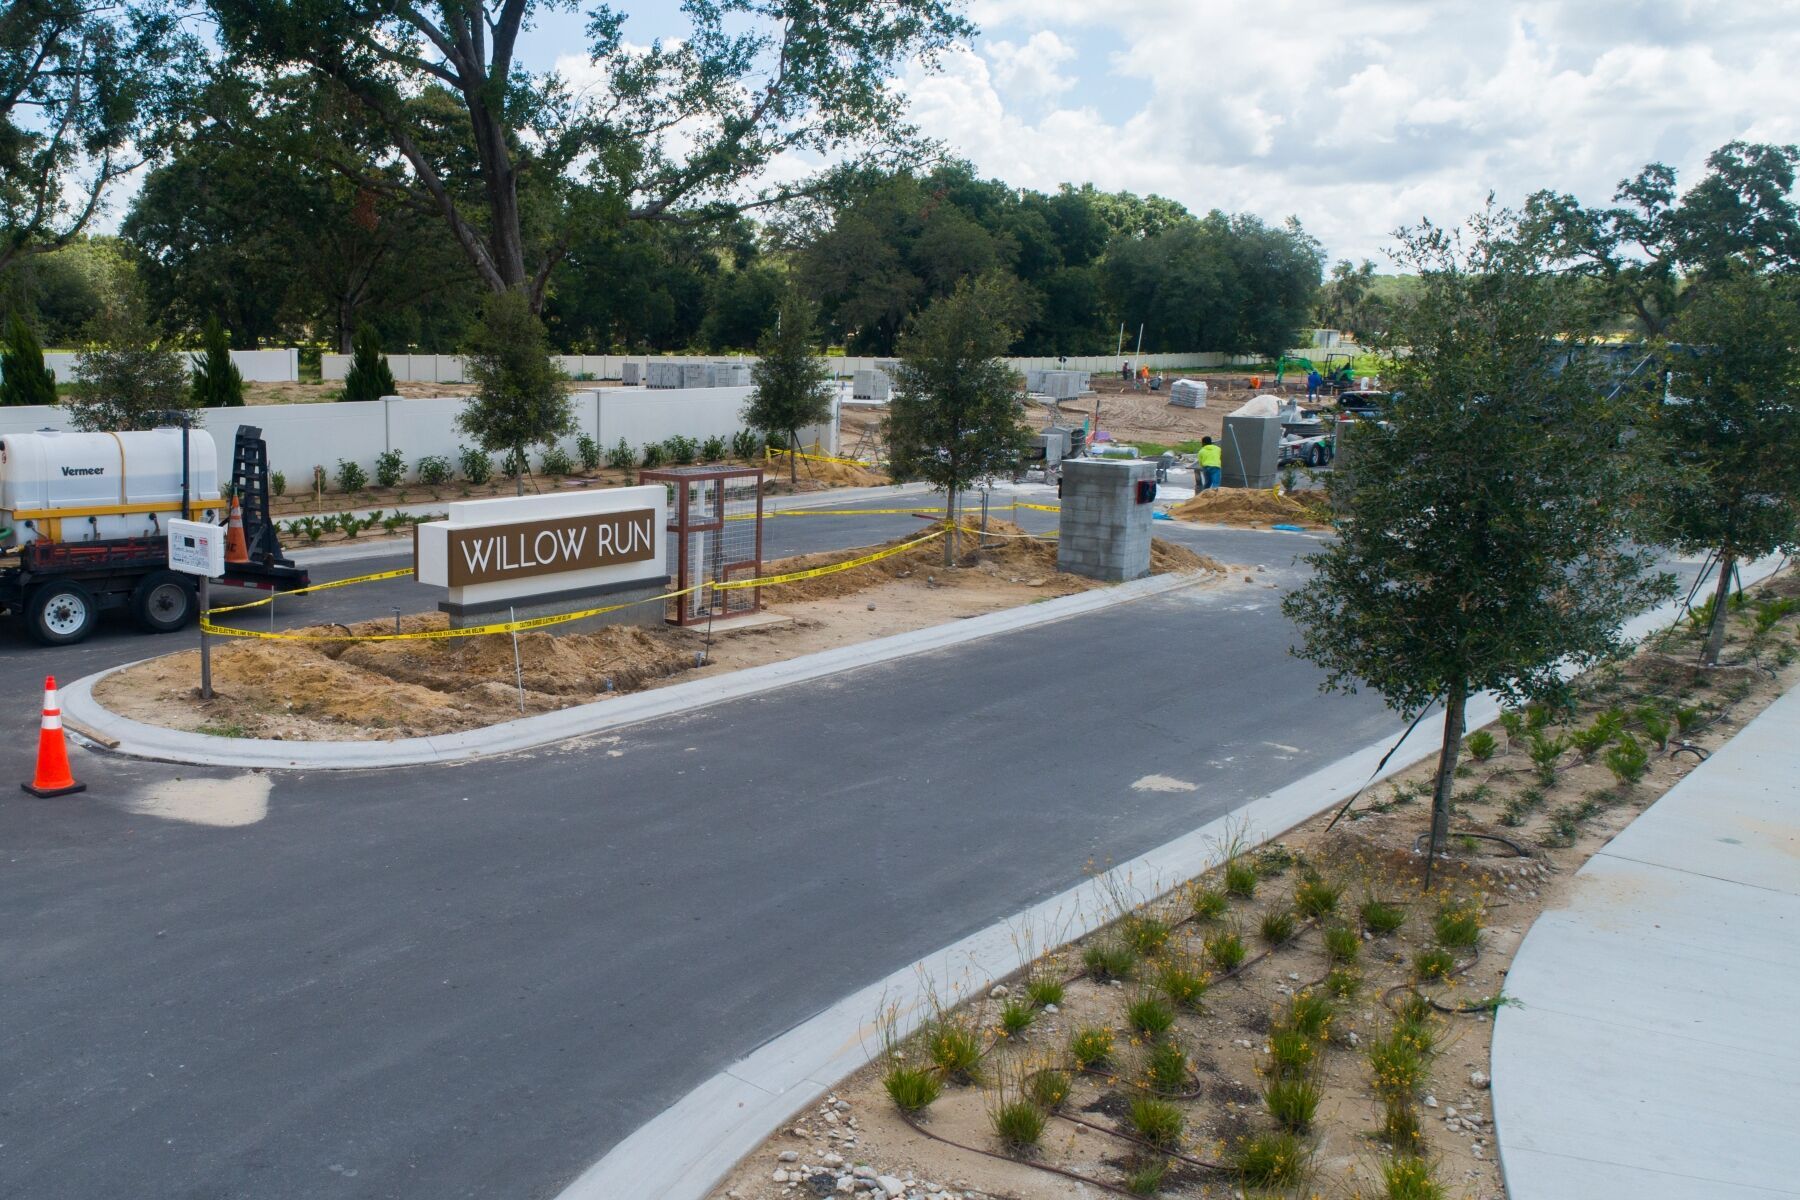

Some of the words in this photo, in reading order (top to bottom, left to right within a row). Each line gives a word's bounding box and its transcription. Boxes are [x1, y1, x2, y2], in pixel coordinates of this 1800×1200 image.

[61, 466, 104, 476] Vermeer
[461, 527, 587, 574] WILLOW
[598, 519, 650, 557] RUN
